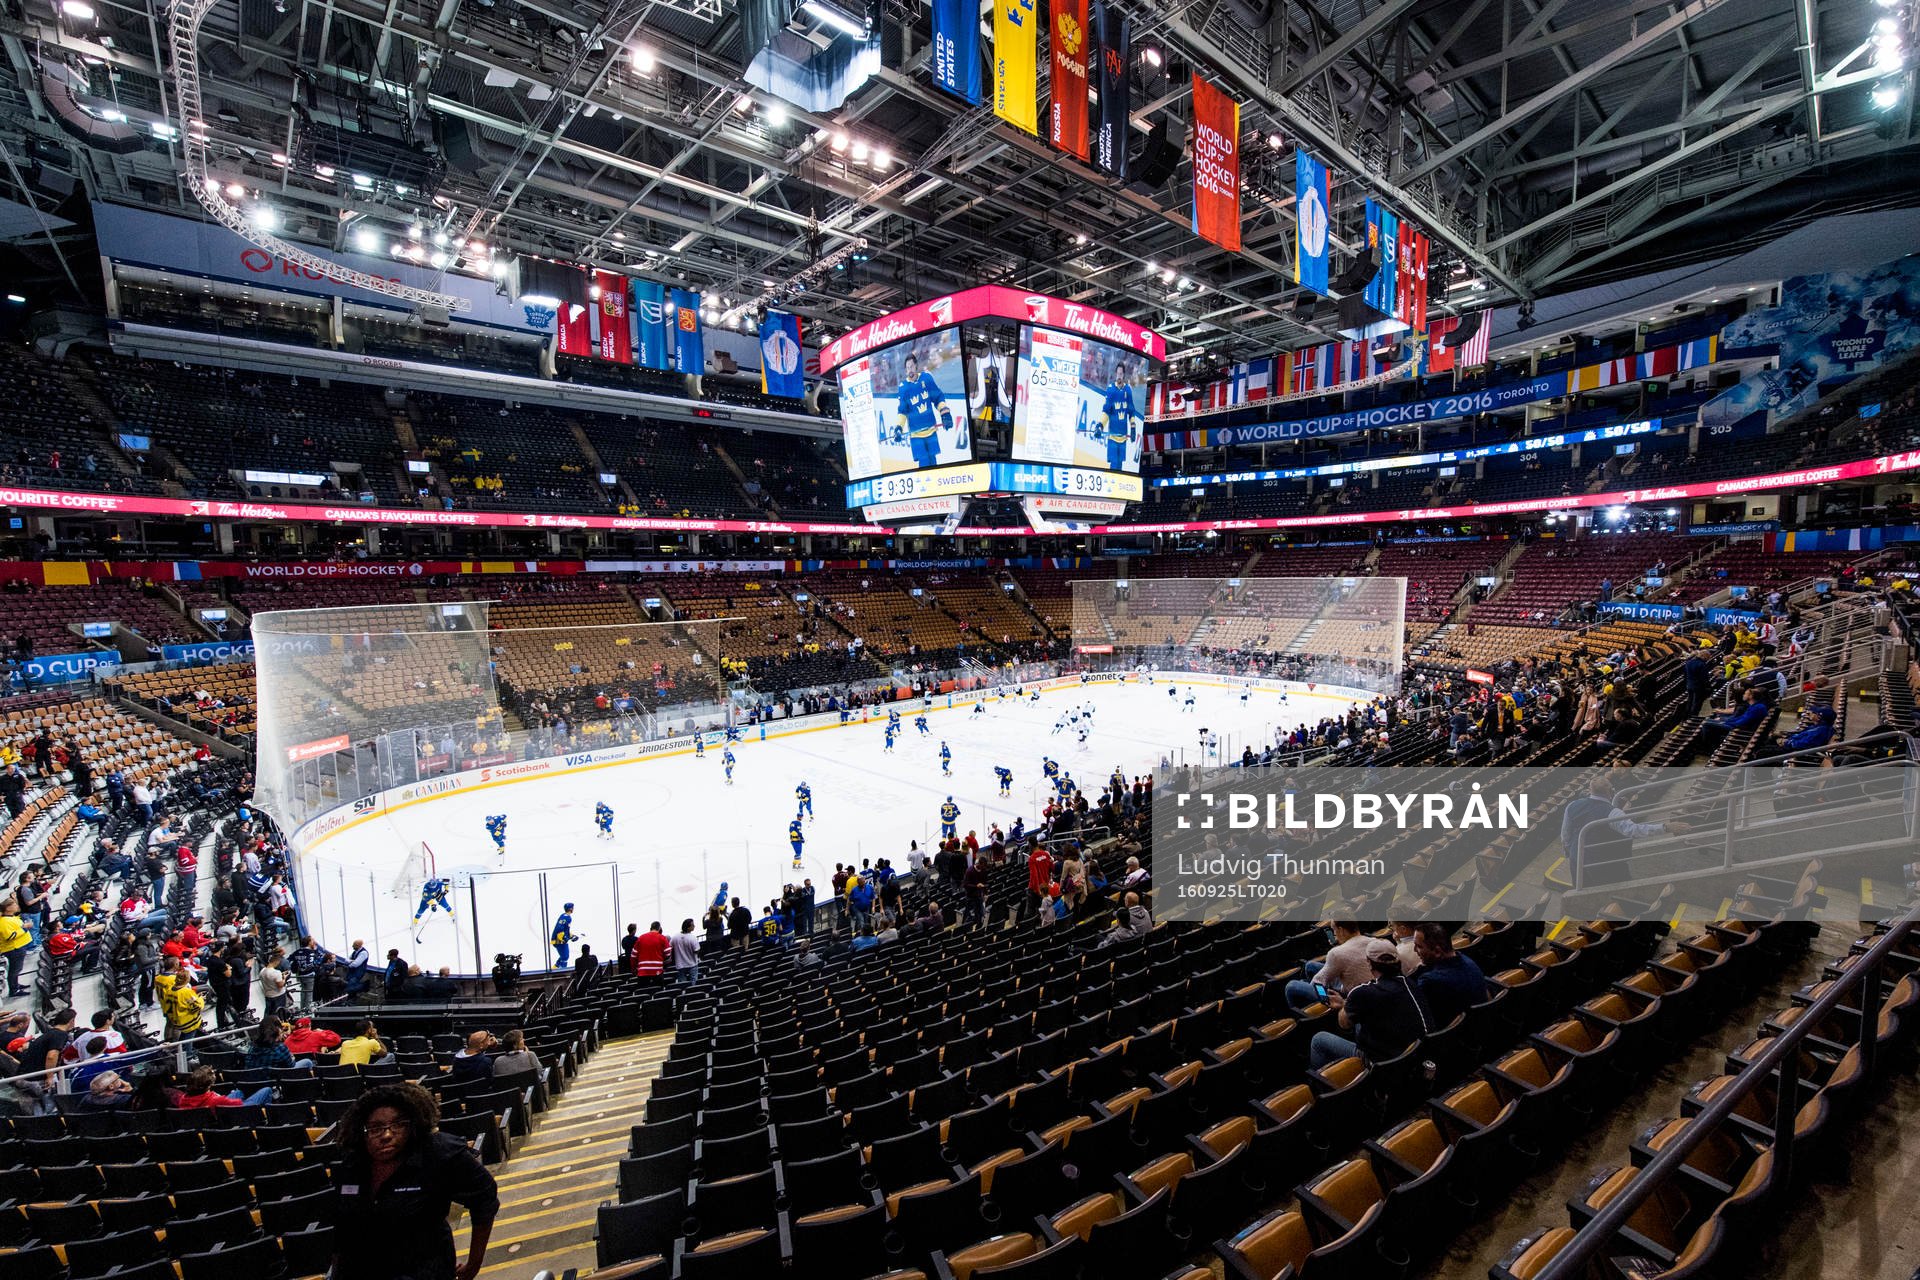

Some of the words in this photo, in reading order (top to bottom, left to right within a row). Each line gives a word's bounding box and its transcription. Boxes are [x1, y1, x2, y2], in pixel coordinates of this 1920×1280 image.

[937, 32, 945, 81] UNITED
[947, 38, 955, 87] STATES
[1053, 103, 1061, 142] RUSSIA
[1197, 120, 1233, 155] WORLD
[1196, 137, 1217, 161] CUP
[1217, 154, 1224, 162] OF
[1195, 153, 1235, 188] HOCKEY
[1196, 170, 1219, 194] 2016
[1063, 304, 1089, 331] Tim
[849, 328, 867, 356] Tim
[1831, 337, 1874, 348] TORONTO
[1837, 344, 1867, 353] MAPLE
[1839, 351, 1865, 360] LEAFS
[1031, 369, 1048, 386] 65
[1237, 423, 1301, 441] WORLD
[1305, 417, 1341, 434] CUP
[1343, 417, 1354, 426] OF
[1356, 400, 1441, 427] HOCKEY
[1445, 392, 1493, 415] 2016
[1497, 382, 1550, 401] TORONTO
[1605, 421, 1651, 437] 50/50
[1710, 424, 1733, 436] 305
[1525, 435, 1565, 450] 50/50
[1519, 452, 1538, 462] 304
[1014, 473, 1049, 485] EUROPE
[1225, 472, 1257, 482] 50/50
[1387, 470, 1402, 478] Bay
[1405, 466, 1430, 475] Street
[887, 477, 914, 497] 9:39
[937, 474, 974, 487] SWEDEN
[1076, 472, 1103, 492] 9:39
[1173, 476, 1202, 486] 50/50
[1263, 480, 1279, 488] 302
[1716, 480, 1758, 493] CANADA'S
[1759, 473, 1805, 488] FAVOURITE
[1806, 469, 1840, 482] COFFEE
[217, 503, 240, 516] Tim
[886, 503, 915, 515] CANADA
[918, 500, 951, 512] CENTRE
[1049, 499, 1063, 508] AIR
[1066, 499, 1097, 509] CANADA
[1099, 501, 1121, 511] CENTRE
[1473, 504, 1507, 515] CANADA'S
[1507, 501, 1548, 512] FAVOURITE
[1548, 499, 1579, 508] COFFEE
[325, 509, 380, 521] CANADA'S
[381, 511, 438, 522] FAVOURITE
[438, 512, 477, 523] COFFEE
[541, 515, 557, 526] Tim
[1277, 518, 1307, 526] CANADA'S
[1307, 516, 1340, 526] FAVOURITE
[1340, 515, 1365, 523] COFFEE
[613, 519, 650, 528] CANADA'S
[650, 520, 689, 529] FAVOURITE
[689, 521, 715, 529] COFFEE
[1107, 525, 1134, 533] CANADA'S
[1134, 525, 1164, 533] FAVOURITE
[1164, 524, 1185, 532] COFFEE
[1690, 526, 1713, 534] WORLD
[1732, 523, 1762, 533] HOCKEY
[246, 566, 305, 577] WORLD
[307, 565, 338, 577] CUP
[348, 565, 405, 576] HOCKEY
[897, 561, 919, 569] WORLD
[938, 560, 963, 568] HOCKEY
[1649, 607, 1672, 621] CUP
[48, 658, 97, 677] CUP
[99, 660, 114, 669] OF
[1087, 672, 1117, 682] sonnet
[1025, 681, 1051, 690] HONDA
[639, 739, 693, 754] BRIDGESTONE
[566, 754, 593, 767] VISA
[594, 751, 626, 763] Checkout
[495, 761, 551, 777] Scotiabank
[415, 777, 463, 798] CANADIAN
[354, 795, 377, 813] SN
[943, 806, 953, 817] 23
[763, 924, 777, 938] 30
